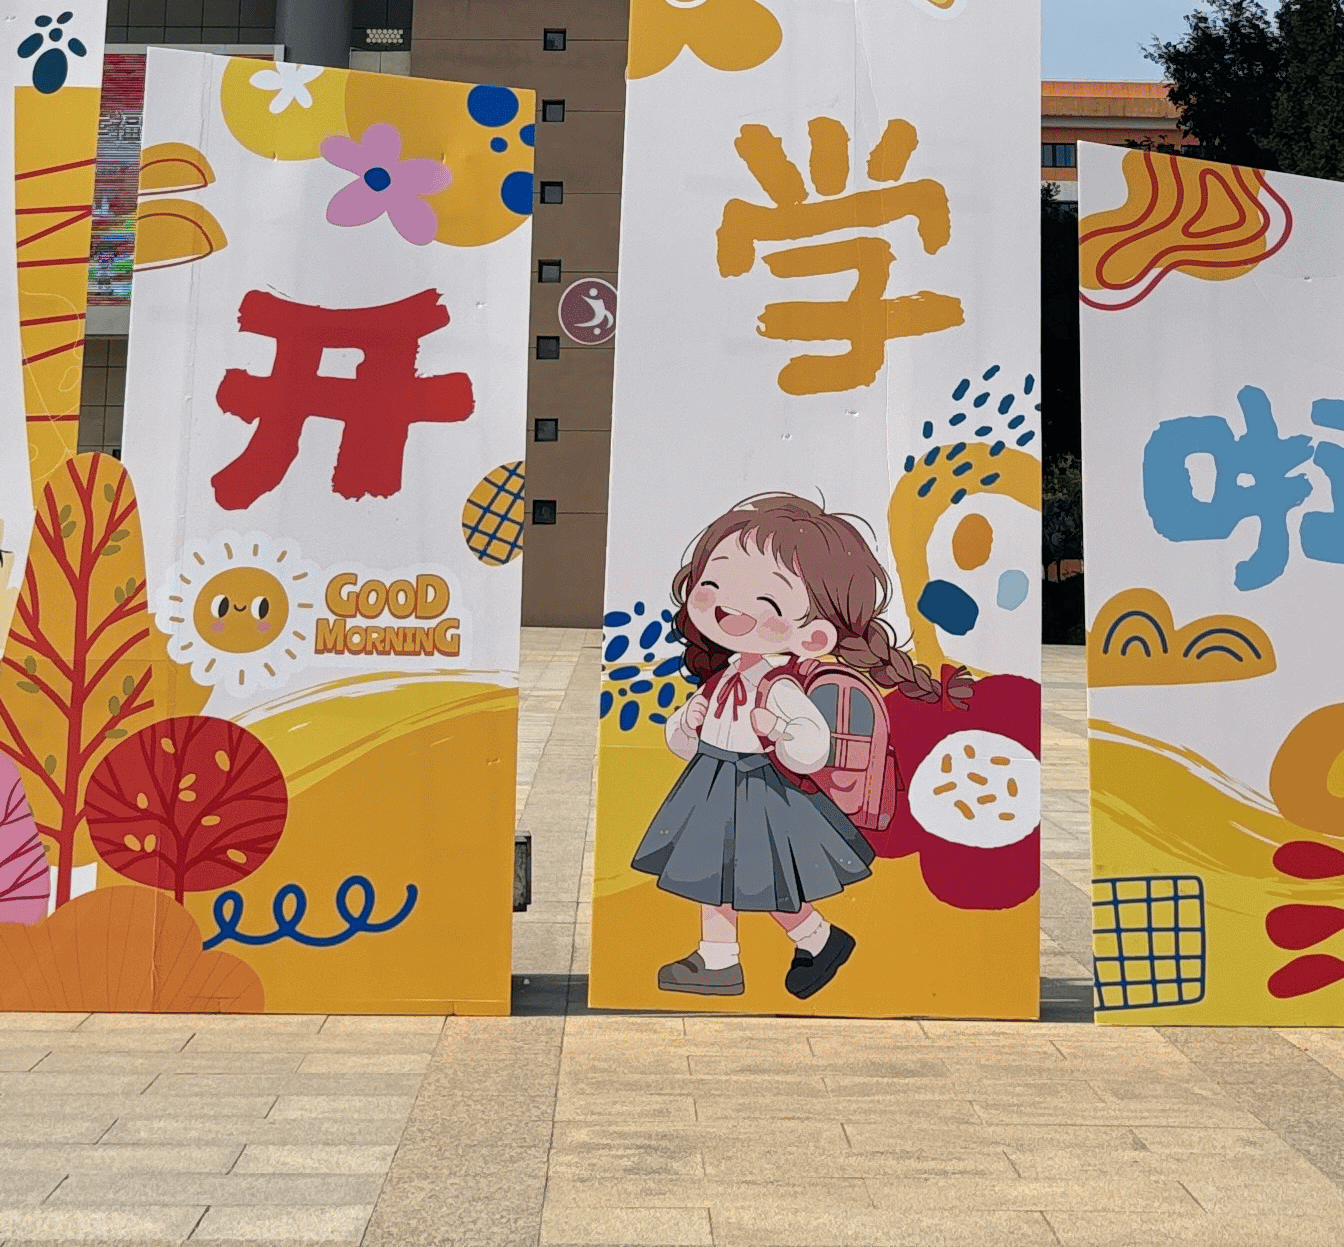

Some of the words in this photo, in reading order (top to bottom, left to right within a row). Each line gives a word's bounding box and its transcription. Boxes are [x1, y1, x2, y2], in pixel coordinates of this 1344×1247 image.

[716, 117, 964, 396] 学
[211, 288, 476, 511] 开
[315, 618, 461, 657] MORNING
[325, 573, 450, 619] GOOD
